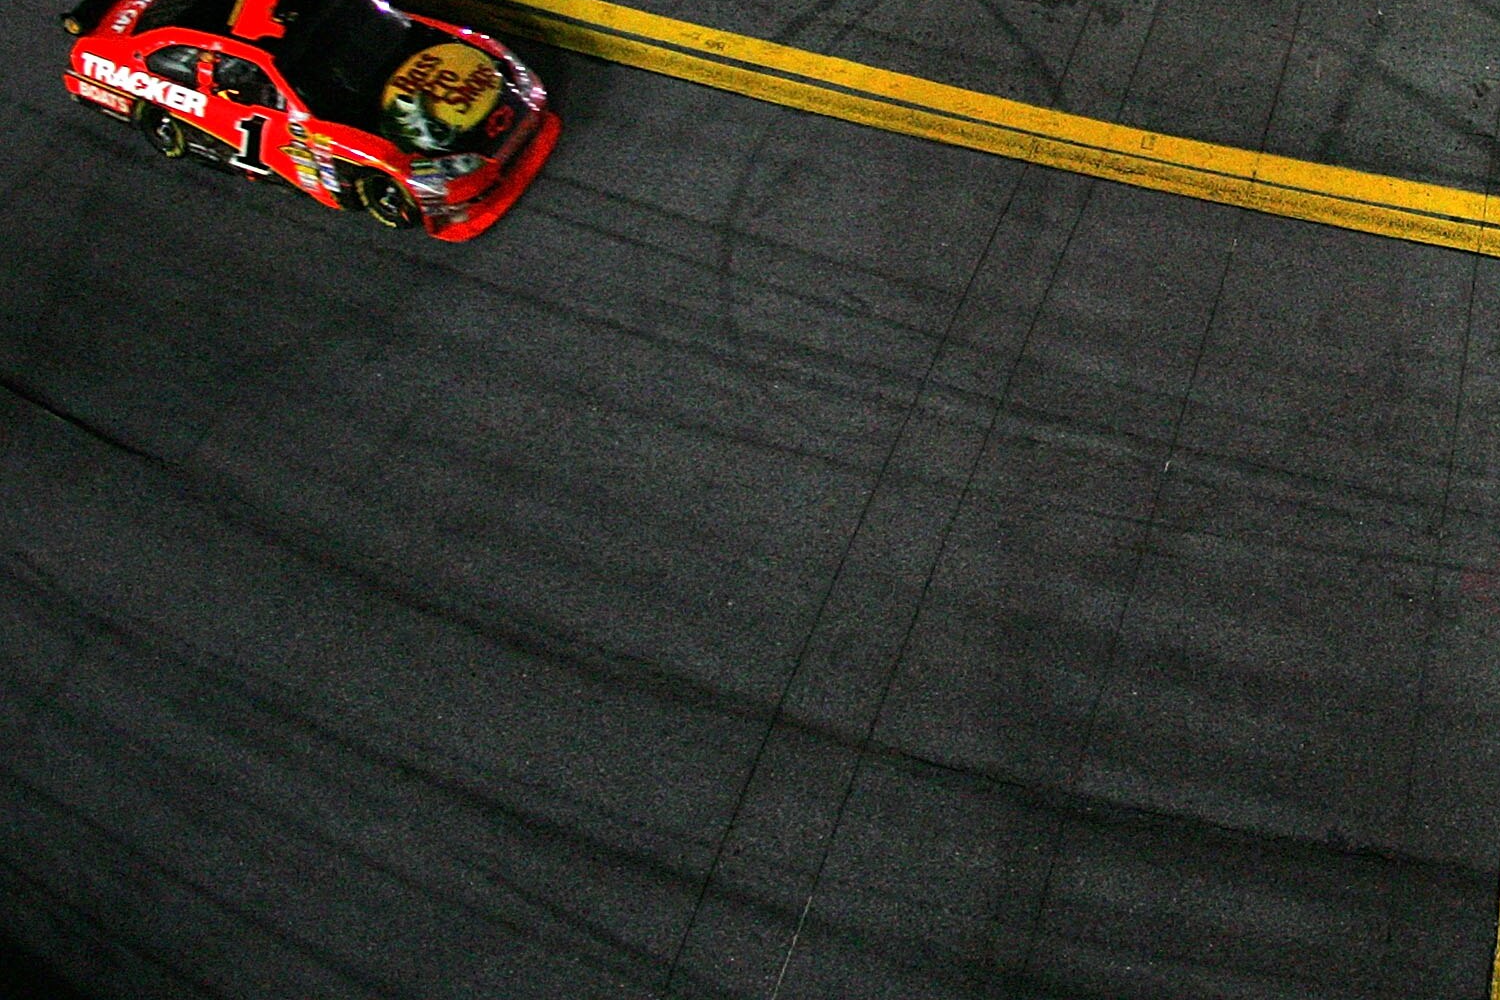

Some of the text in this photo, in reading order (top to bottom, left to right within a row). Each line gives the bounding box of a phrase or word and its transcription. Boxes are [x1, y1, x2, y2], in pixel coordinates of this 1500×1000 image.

[79, 82, 131, 114] BOATS
[80, 51, 207, 118] TRACKER
[391, 53, 443, 94] Bass
[229, 113, 272, 175] 1
